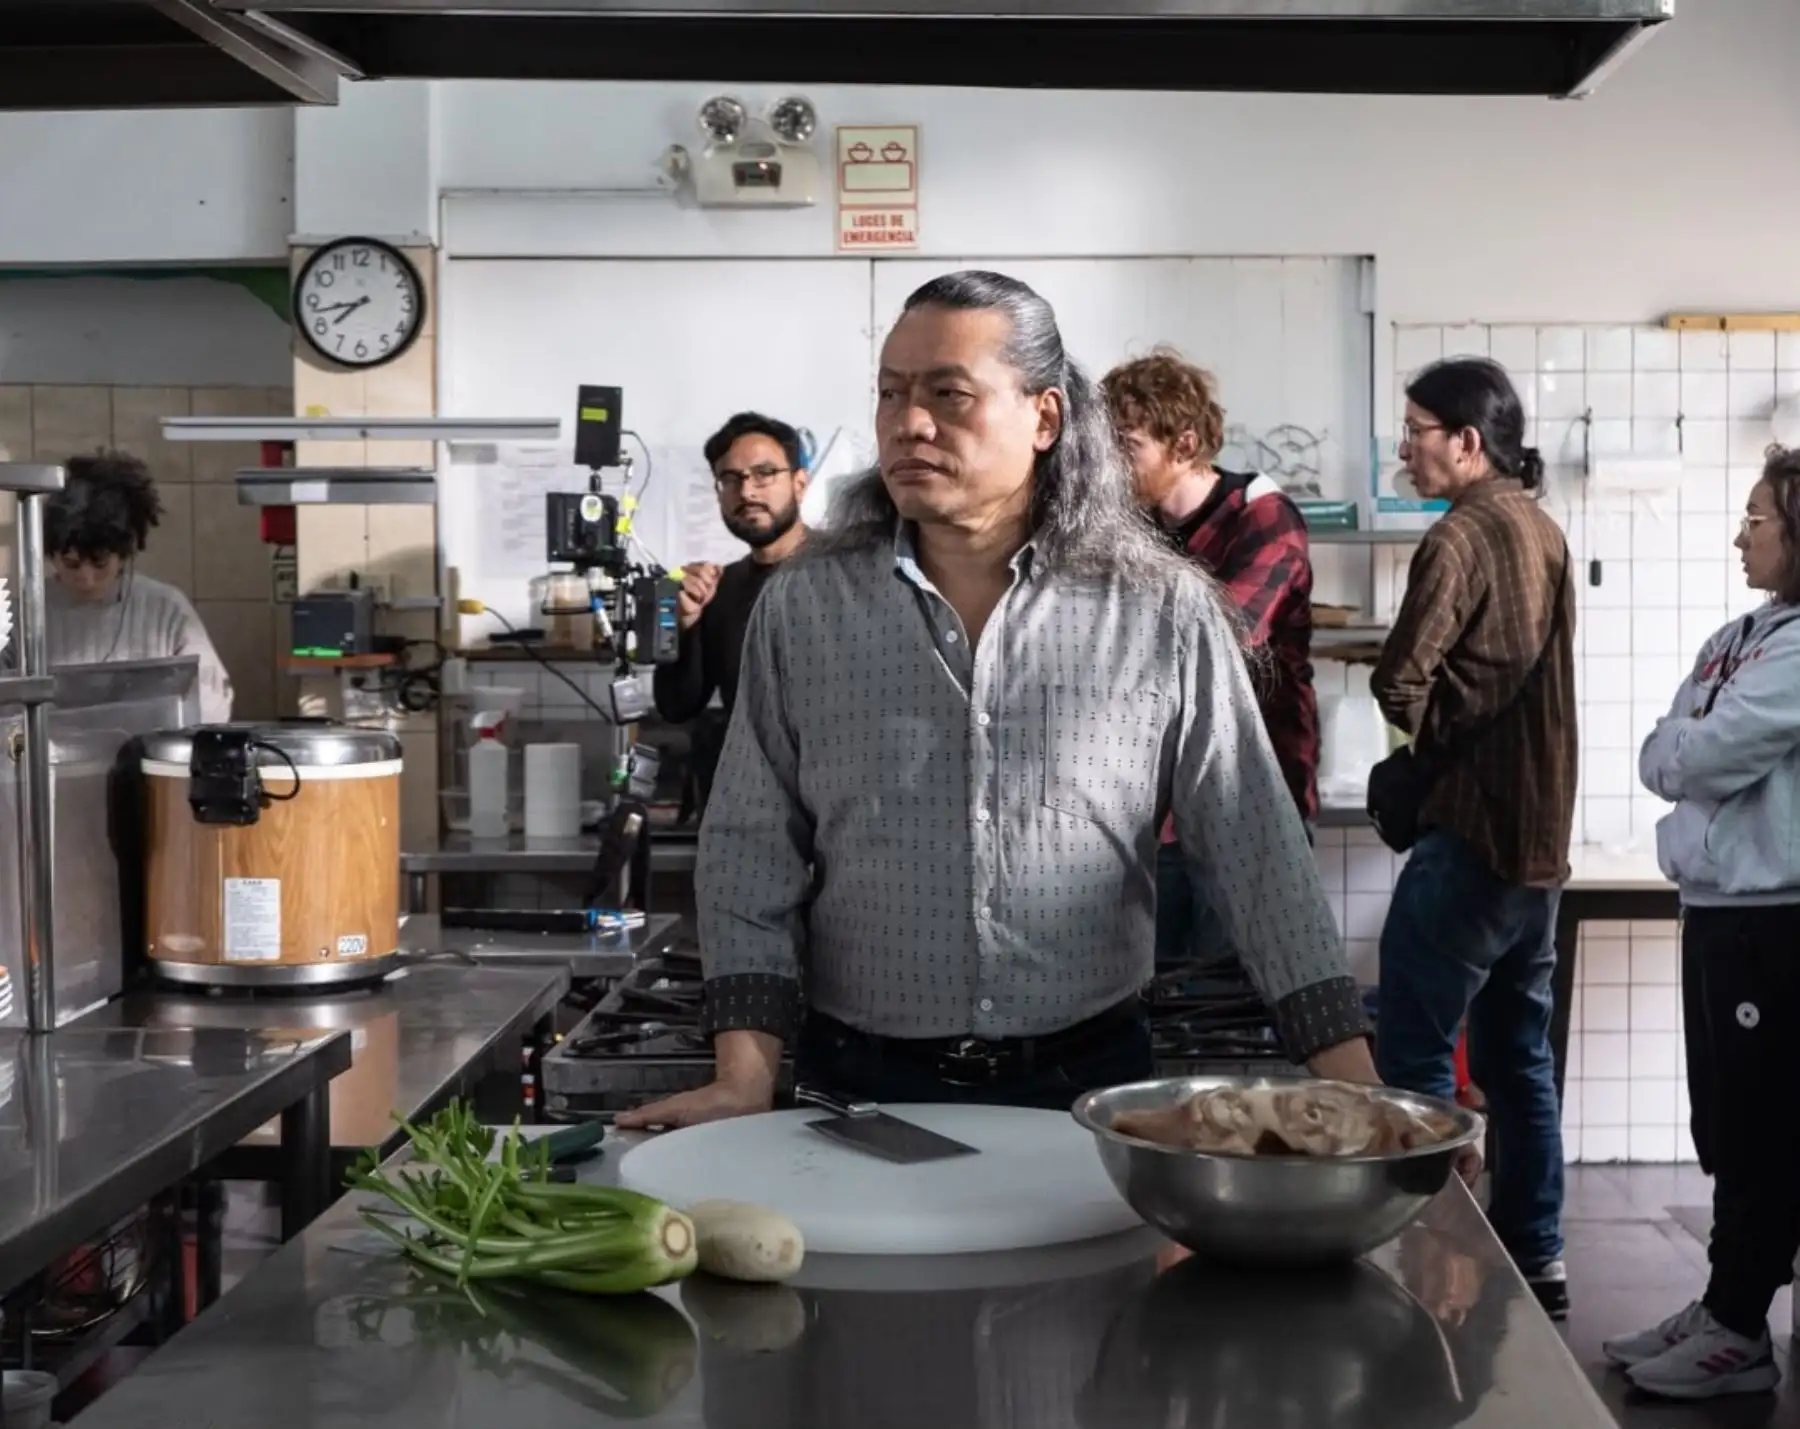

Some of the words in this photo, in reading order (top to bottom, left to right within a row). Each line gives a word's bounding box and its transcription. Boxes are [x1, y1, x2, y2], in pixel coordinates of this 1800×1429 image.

[852, 214, 886, 227] LUCES
[890, 214, 903, 227] DE
[843, 231, 915, 243] EMERGENCIA
[333, 253, 344, 271] 11
[351, 248, 370, 267] 12
[380, 254, 386, 272] 1
[314, 270, 334, 288] 10
[395, 268, 409, 289] 2
[305, 293, 319, 313] 9
[400, 294, 413, 313] 3
[313, 316, 328, 336] 8
[394, 320, 406, 340] 4
[335, 333, 346, 353] 7
[354, 339, 369, 358] 6
[378, 334, 390, 353] 5
